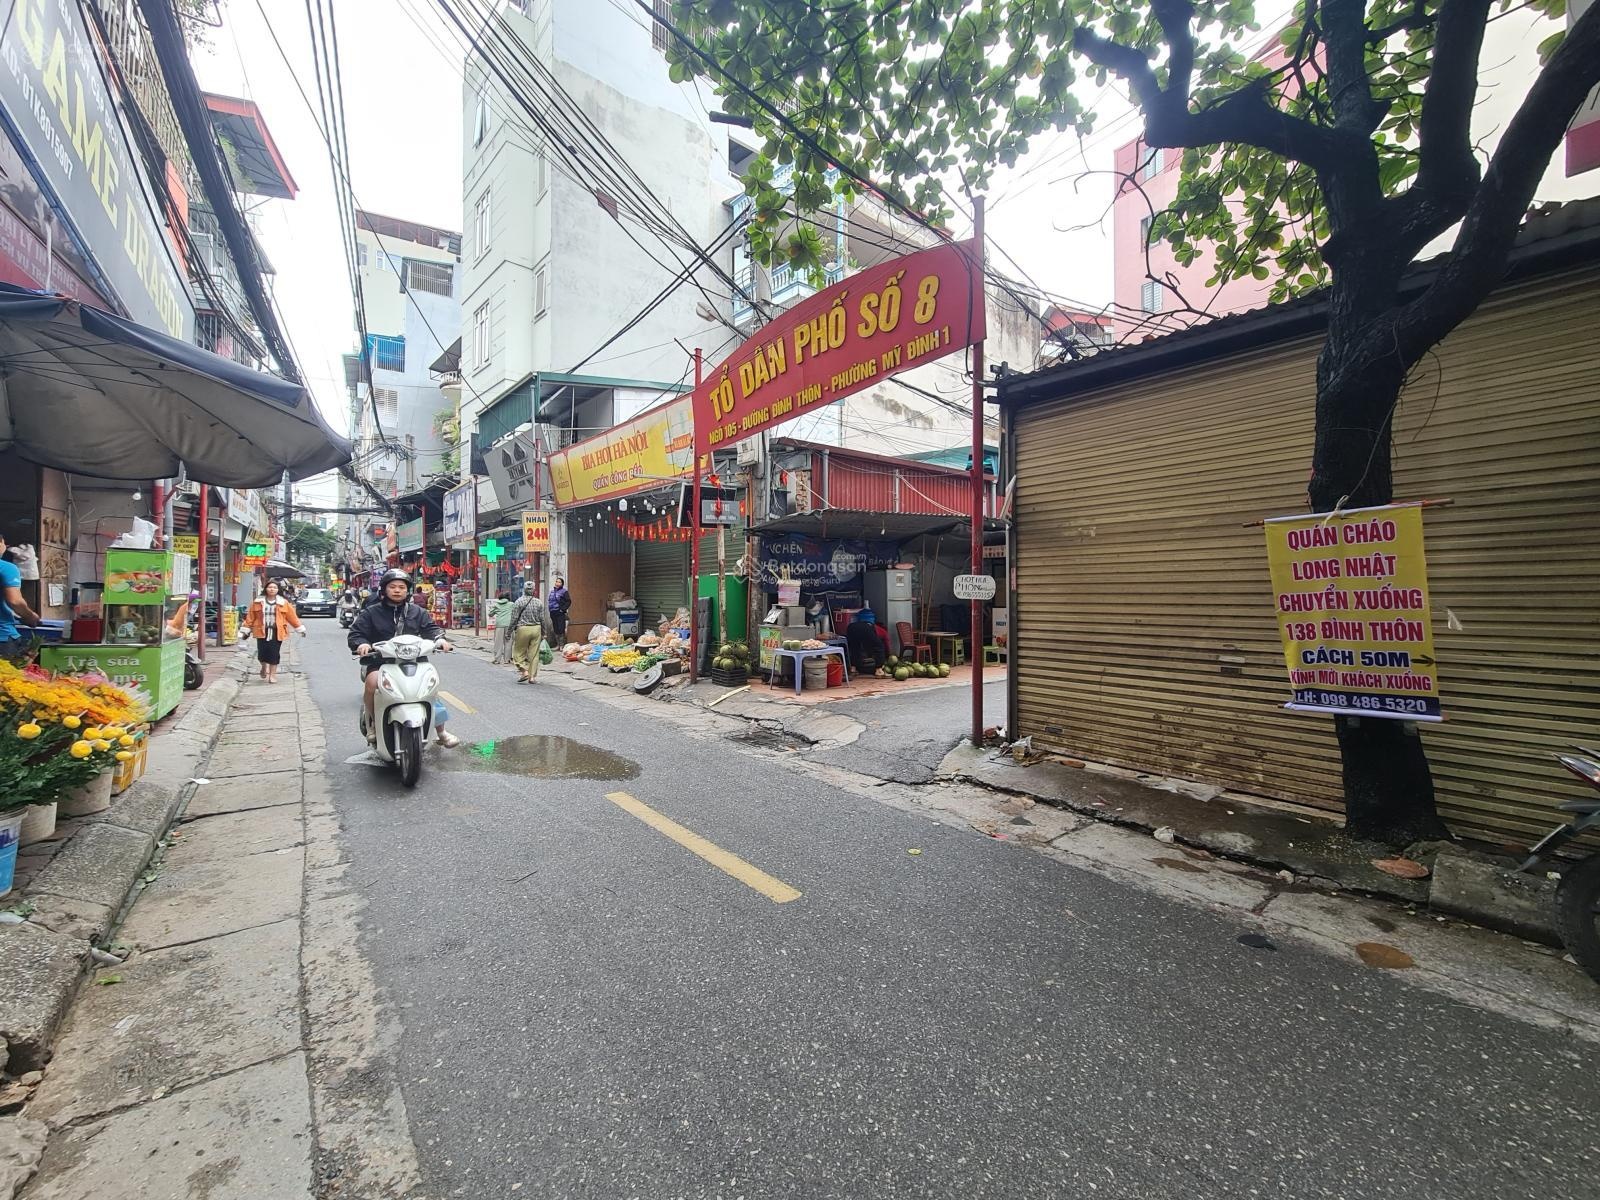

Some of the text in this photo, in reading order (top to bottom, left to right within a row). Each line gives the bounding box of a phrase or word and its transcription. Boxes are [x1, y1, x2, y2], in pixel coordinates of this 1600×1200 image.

[16, 0, 118, 231] GAME
[124, 192, 184, 341] DRAGON
[35, 242, 80, 297] INERNET
[709, 269, 940, 421] TỔ DÂN PHỐ SỐ 8
[724, 424, 737, 440] 105
[742, 406, 770, 432] ĐƯỜNG
[772, 396, 793, 419] ĐÌNH
[831, 362, 877, 393] PHƯỜNG
[882, 344, 903, 371] MỸ
[907, 331, 941, 362] ĐÌNH
[943, 326, 951, 345] 1
[612, 437, 629, 459] HÀ
[628, 431, 649, 456] NỘI
[593, 473, 609, 491] QUÁN
[610, 470, 628, 485] CÔNG
[527, 527, 548, 541] 24H
[1287, 518, 1397, 551] QUÁN CHÁO
[1292, 552, 1397, 581] LONG NHẬT
[1279, 583, 1424, 612] CHUYỂN XUỐNG
[1285, 617, 1424, 642] 138 ĐÌNH THÔN
[64, 655, 140, 667] Trà sữa
[1302, 646, 1410, 668] CÁCH 50M
[114, 671, 148, 683] mía
[1291, 668, 1432, 692] KÍNH MỜI KHÁCH XUỐNG
[1295, 692, 1427, 713] LH: 098 486 5320
